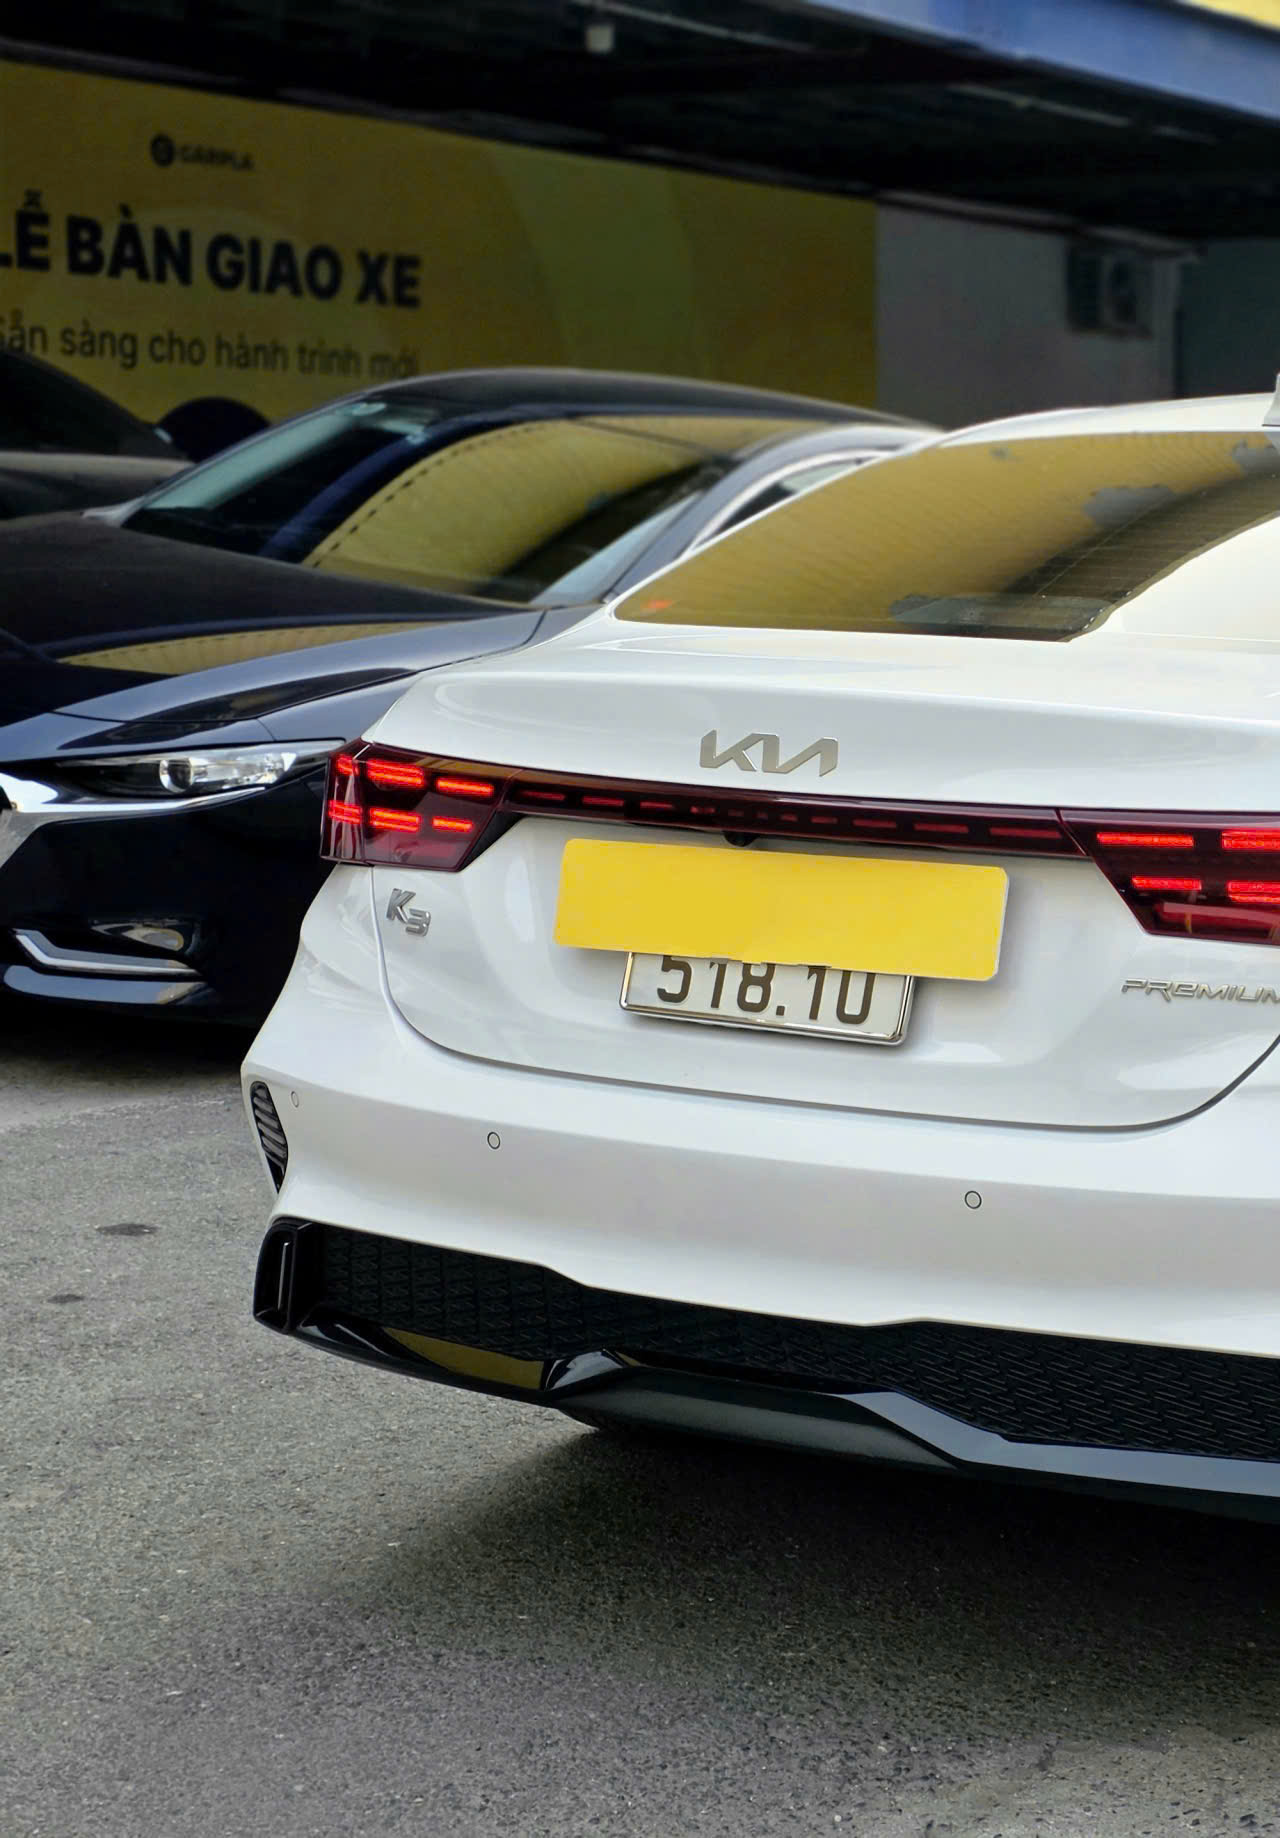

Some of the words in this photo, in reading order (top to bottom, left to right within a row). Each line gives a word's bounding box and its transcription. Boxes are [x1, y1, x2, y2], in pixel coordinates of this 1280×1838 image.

[66, 204, 193, 286] BÀN
[206, 233, 343, 301] GIAO
[355, 250, 422, 308] XE
[148, 331, 207, 366] cho
[386, 887, 431, 937] K3
